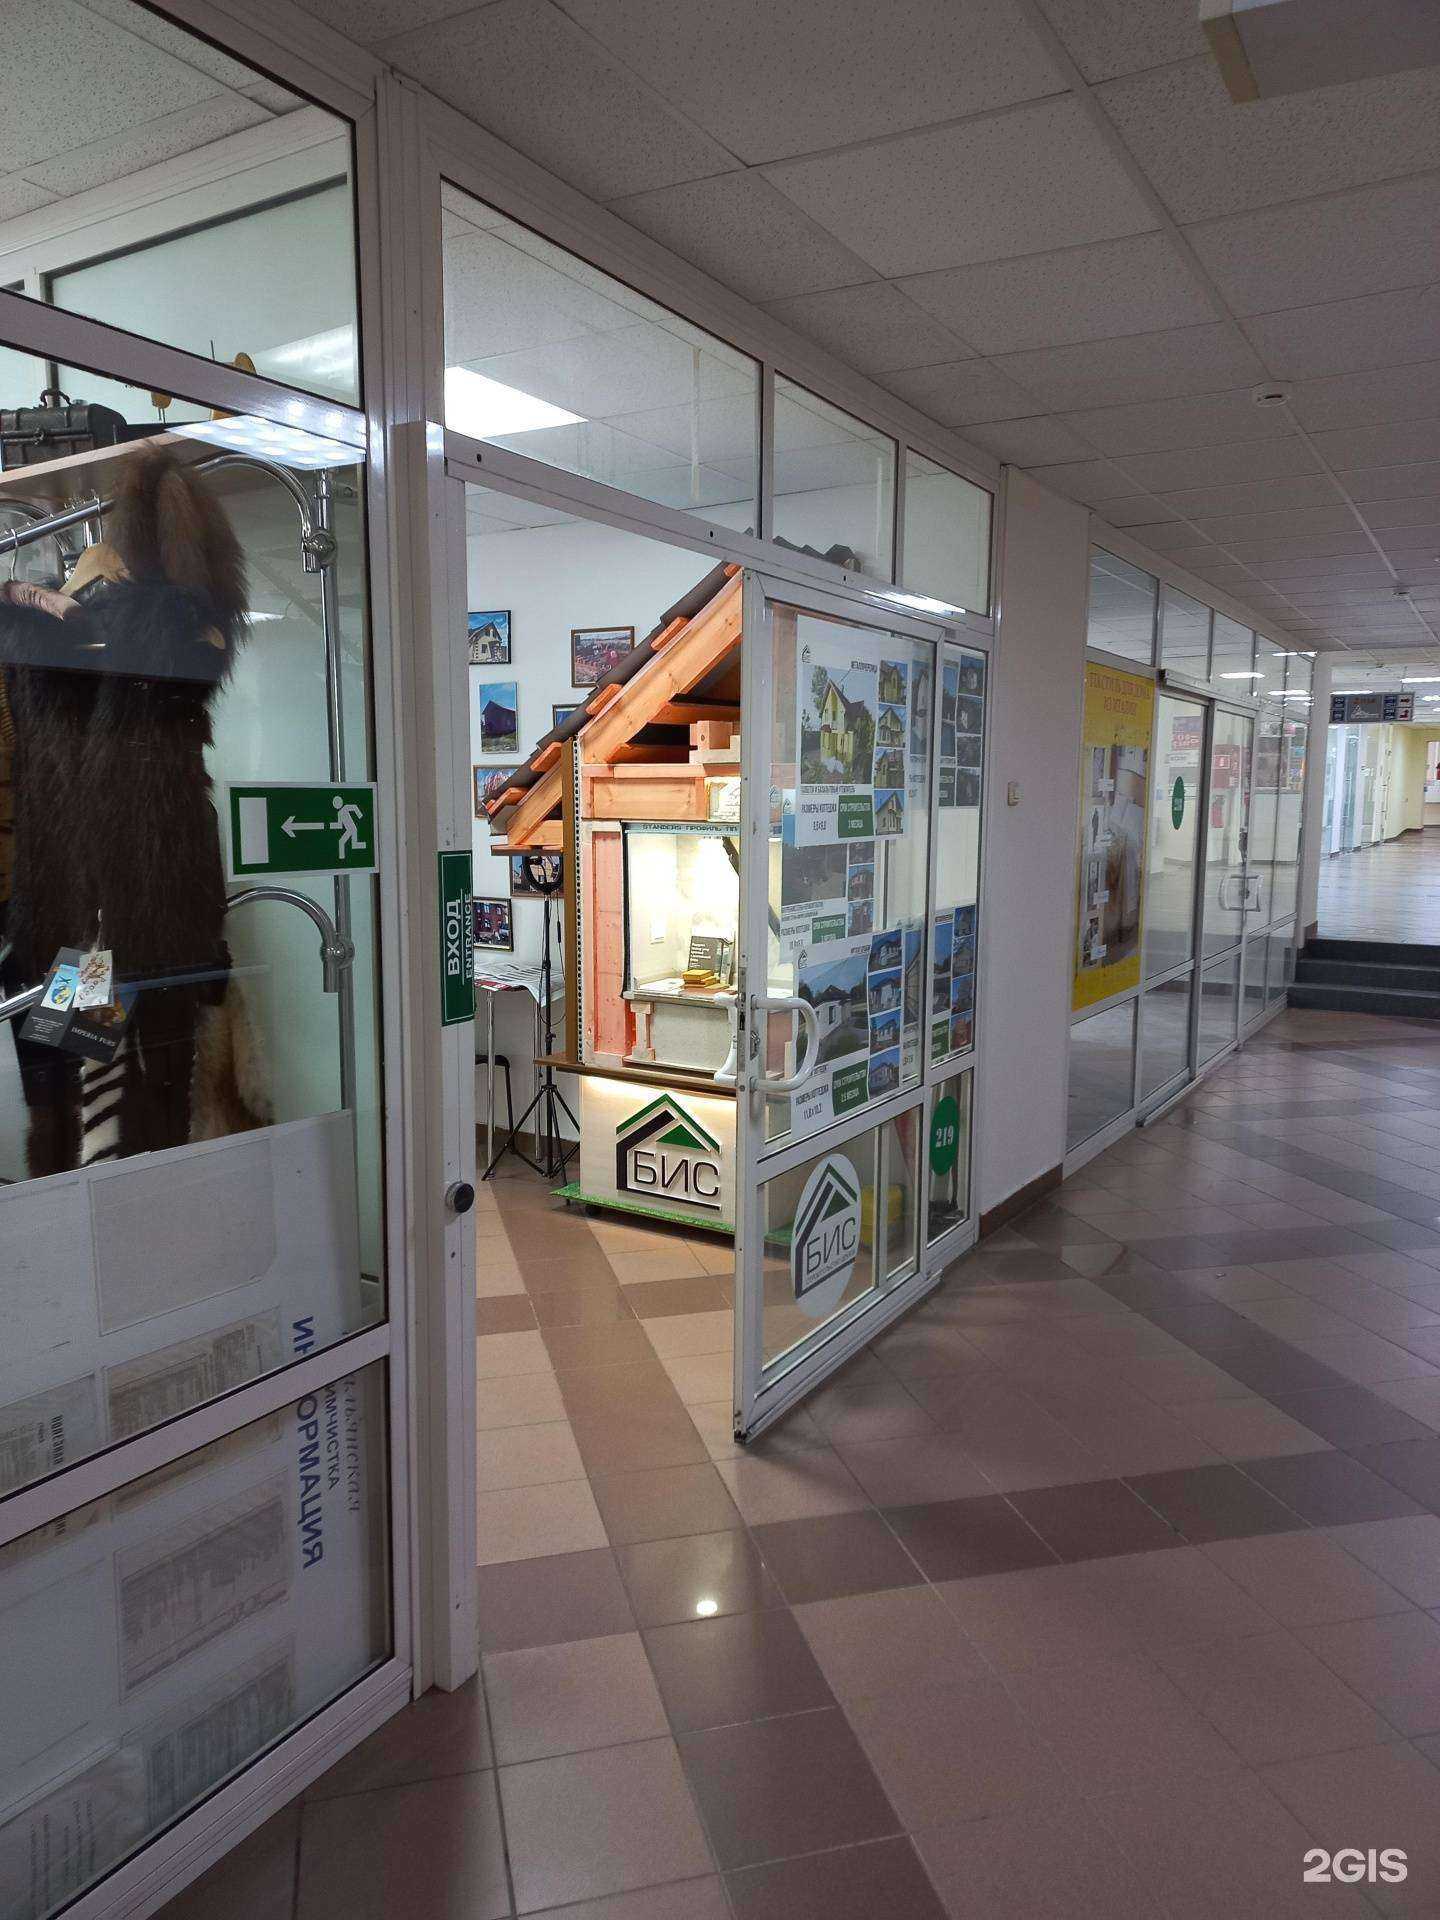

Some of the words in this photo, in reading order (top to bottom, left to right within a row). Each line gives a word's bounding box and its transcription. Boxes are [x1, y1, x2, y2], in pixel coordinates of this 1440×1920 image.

[446, 899, 461, 976] ВХОД
[464, 892, 473, 979] ENTRANCE
[936, 1125, 954, 1147] 219
[633, 1150, 719, 1197] БИС
[807, 1216, 856, 1275] БИС
